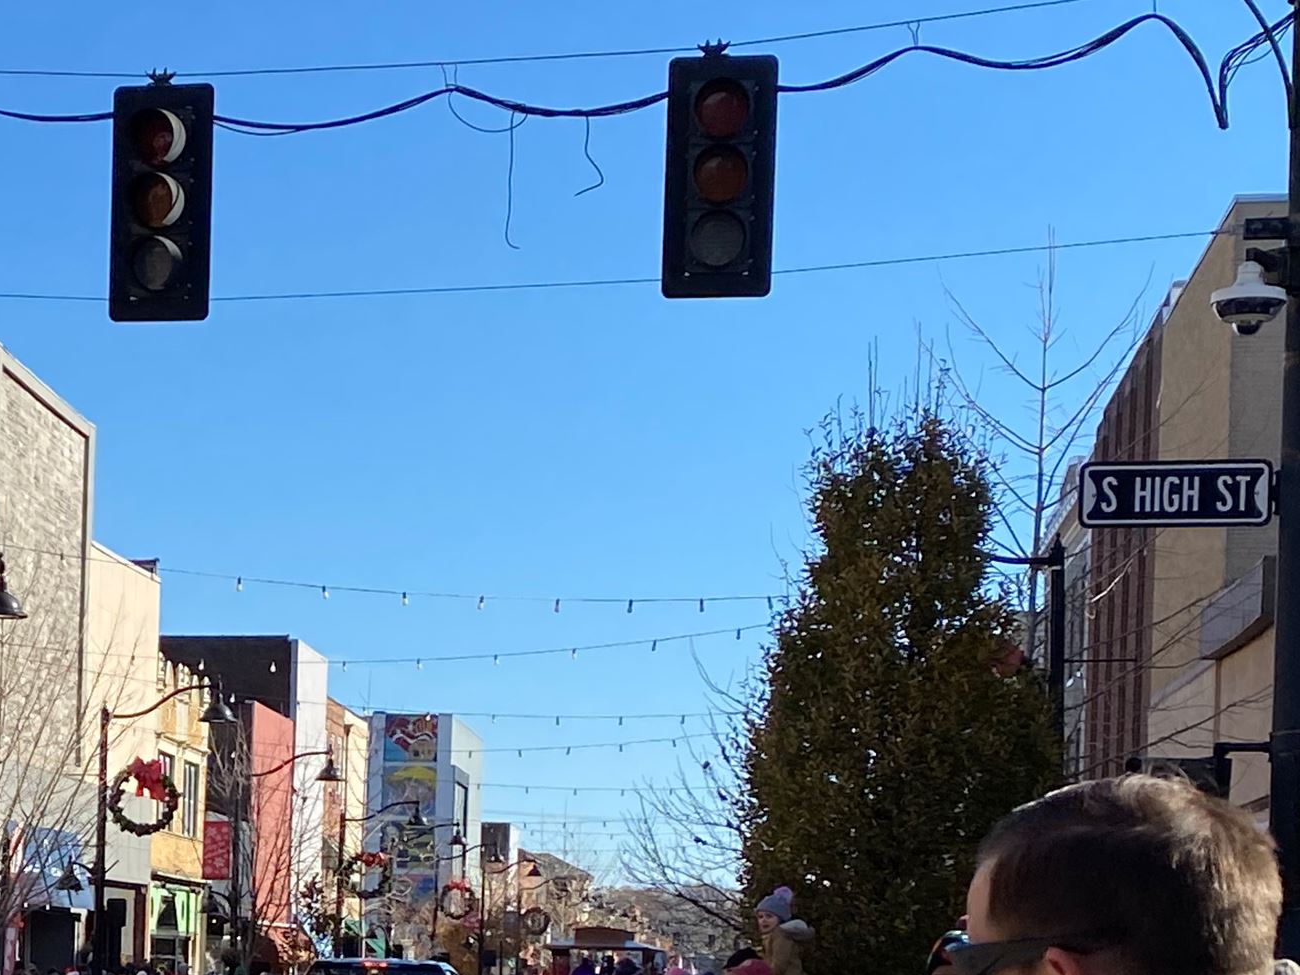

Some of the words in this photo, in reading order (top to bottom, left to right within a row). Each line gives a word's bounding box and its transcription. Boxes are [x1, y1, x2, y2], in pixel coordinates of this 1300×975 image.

[1100, 476, 1118, 512] S
[1134, 476, 1200, 512] HIGH
[1216, 475, 1251, 512] ST
